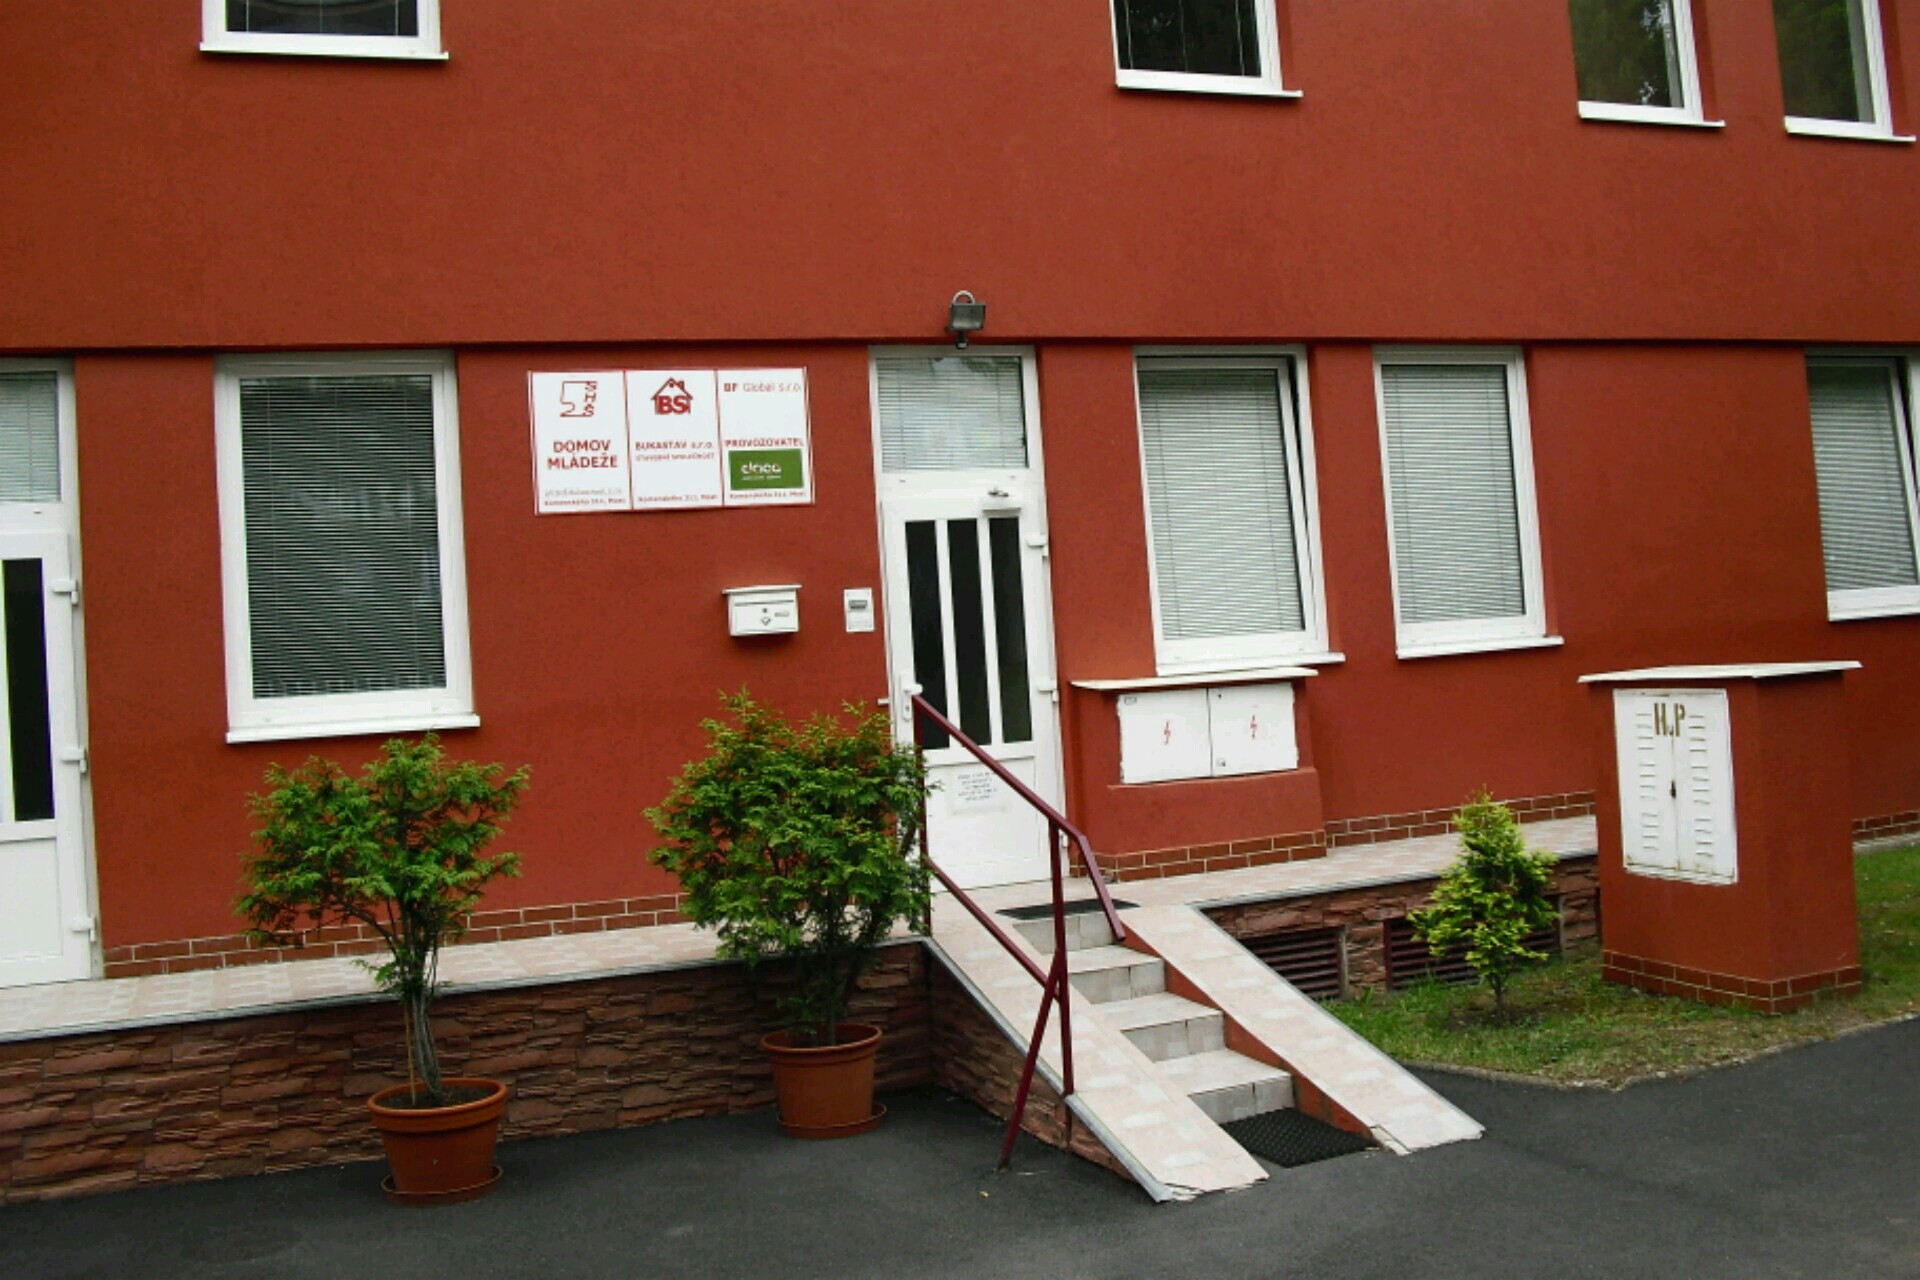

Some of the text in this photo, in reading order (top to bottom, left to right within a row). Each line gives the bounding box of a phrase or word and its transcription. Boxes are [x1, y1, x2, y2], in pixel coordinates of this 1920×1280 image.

[656, 395, 690, 415] BS
[553, 439, 611, 453] DOMOV
[725, 437, 804, 447] PROVOZOVATEL
[547, 452, 618, 470] MLÁDEŽE
